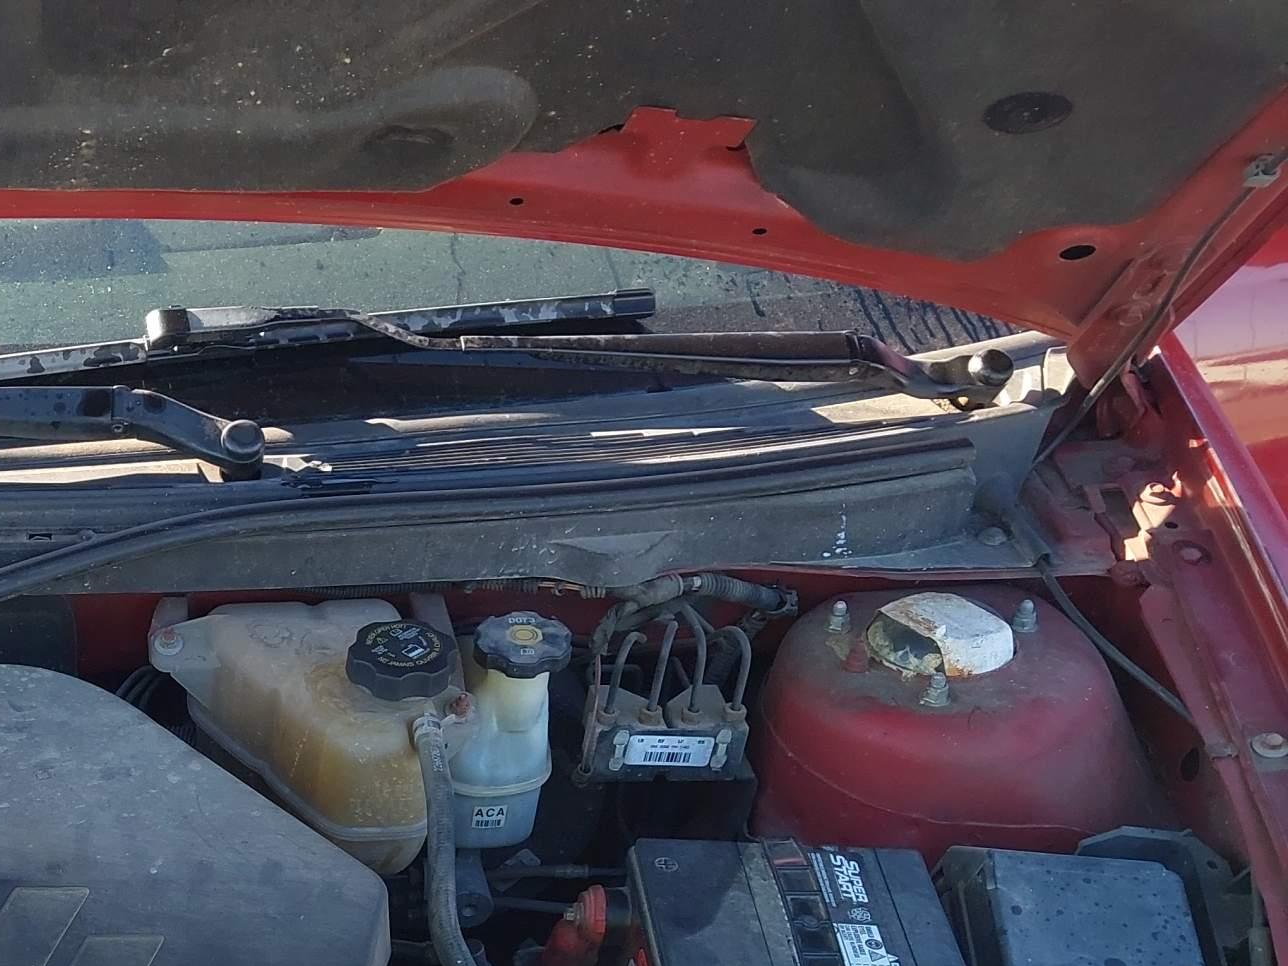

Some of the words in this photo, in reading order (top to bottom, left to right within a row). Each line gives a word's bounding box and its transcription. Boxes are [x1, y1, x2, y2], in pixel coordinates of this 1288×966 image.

[475, 808, 504, 817] ACA
[830, 854, 857, 902] START
[848, 861, 868, 903] SUPER
